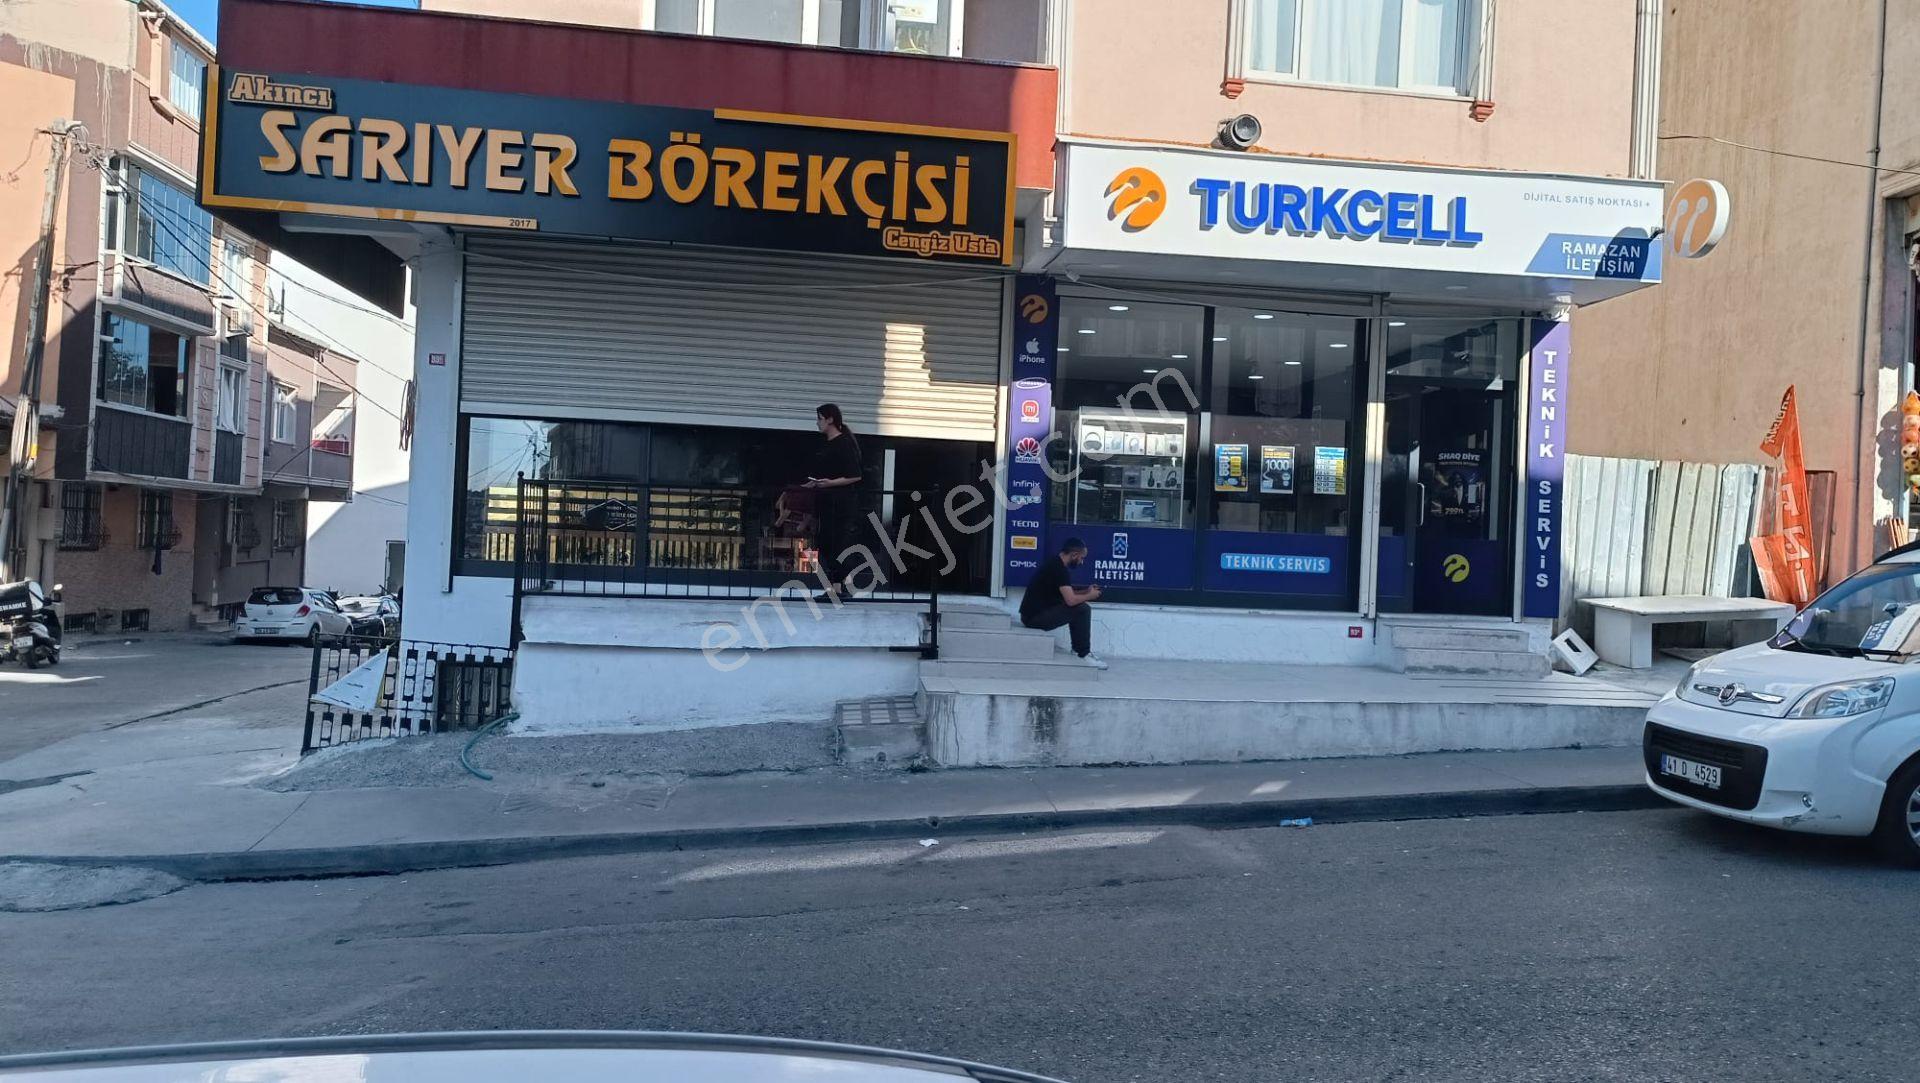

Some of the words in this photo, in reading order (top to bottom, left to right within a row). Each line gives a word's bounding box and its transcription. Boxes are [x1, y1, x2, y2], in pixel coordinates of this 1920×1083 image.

[230, 74, 331, 108] Akıncı
[259, 110, 580, 195] SARIYER
[607, 131, 971, 229] BÖREKÇİSİ
[1196, 177, 1484, 243] TURKCELL
[1597, 197, 1643, 208] NOKTASI
[509, 218, 531, 228] 2017
[885, 229, 949, 256] Cengiz
[953, 232, 998, 257] Usta
[1562, 241, 1640, 258] RAMAZAN
[1566, 254, 1635, 275] İLETİŞİM
[1019, 353, 1046, 364] iPhone
[1538, 350, 1558, 458] TEKNİK
[1013, 480, 1041, 488] Infinix
[1012, 520, 1040, 528] TECNO
[1535, 480, 1552, 588] SERVİS
[1095, 560, 1144, 570] RAMAZAN
[1225, 555, 1276, 569] TEKNİK
[1278, 557, 1326, 571] SERVİS
[1667, 757, 1677, 773] 41
[1694, 764, 1718, 784] 4529
